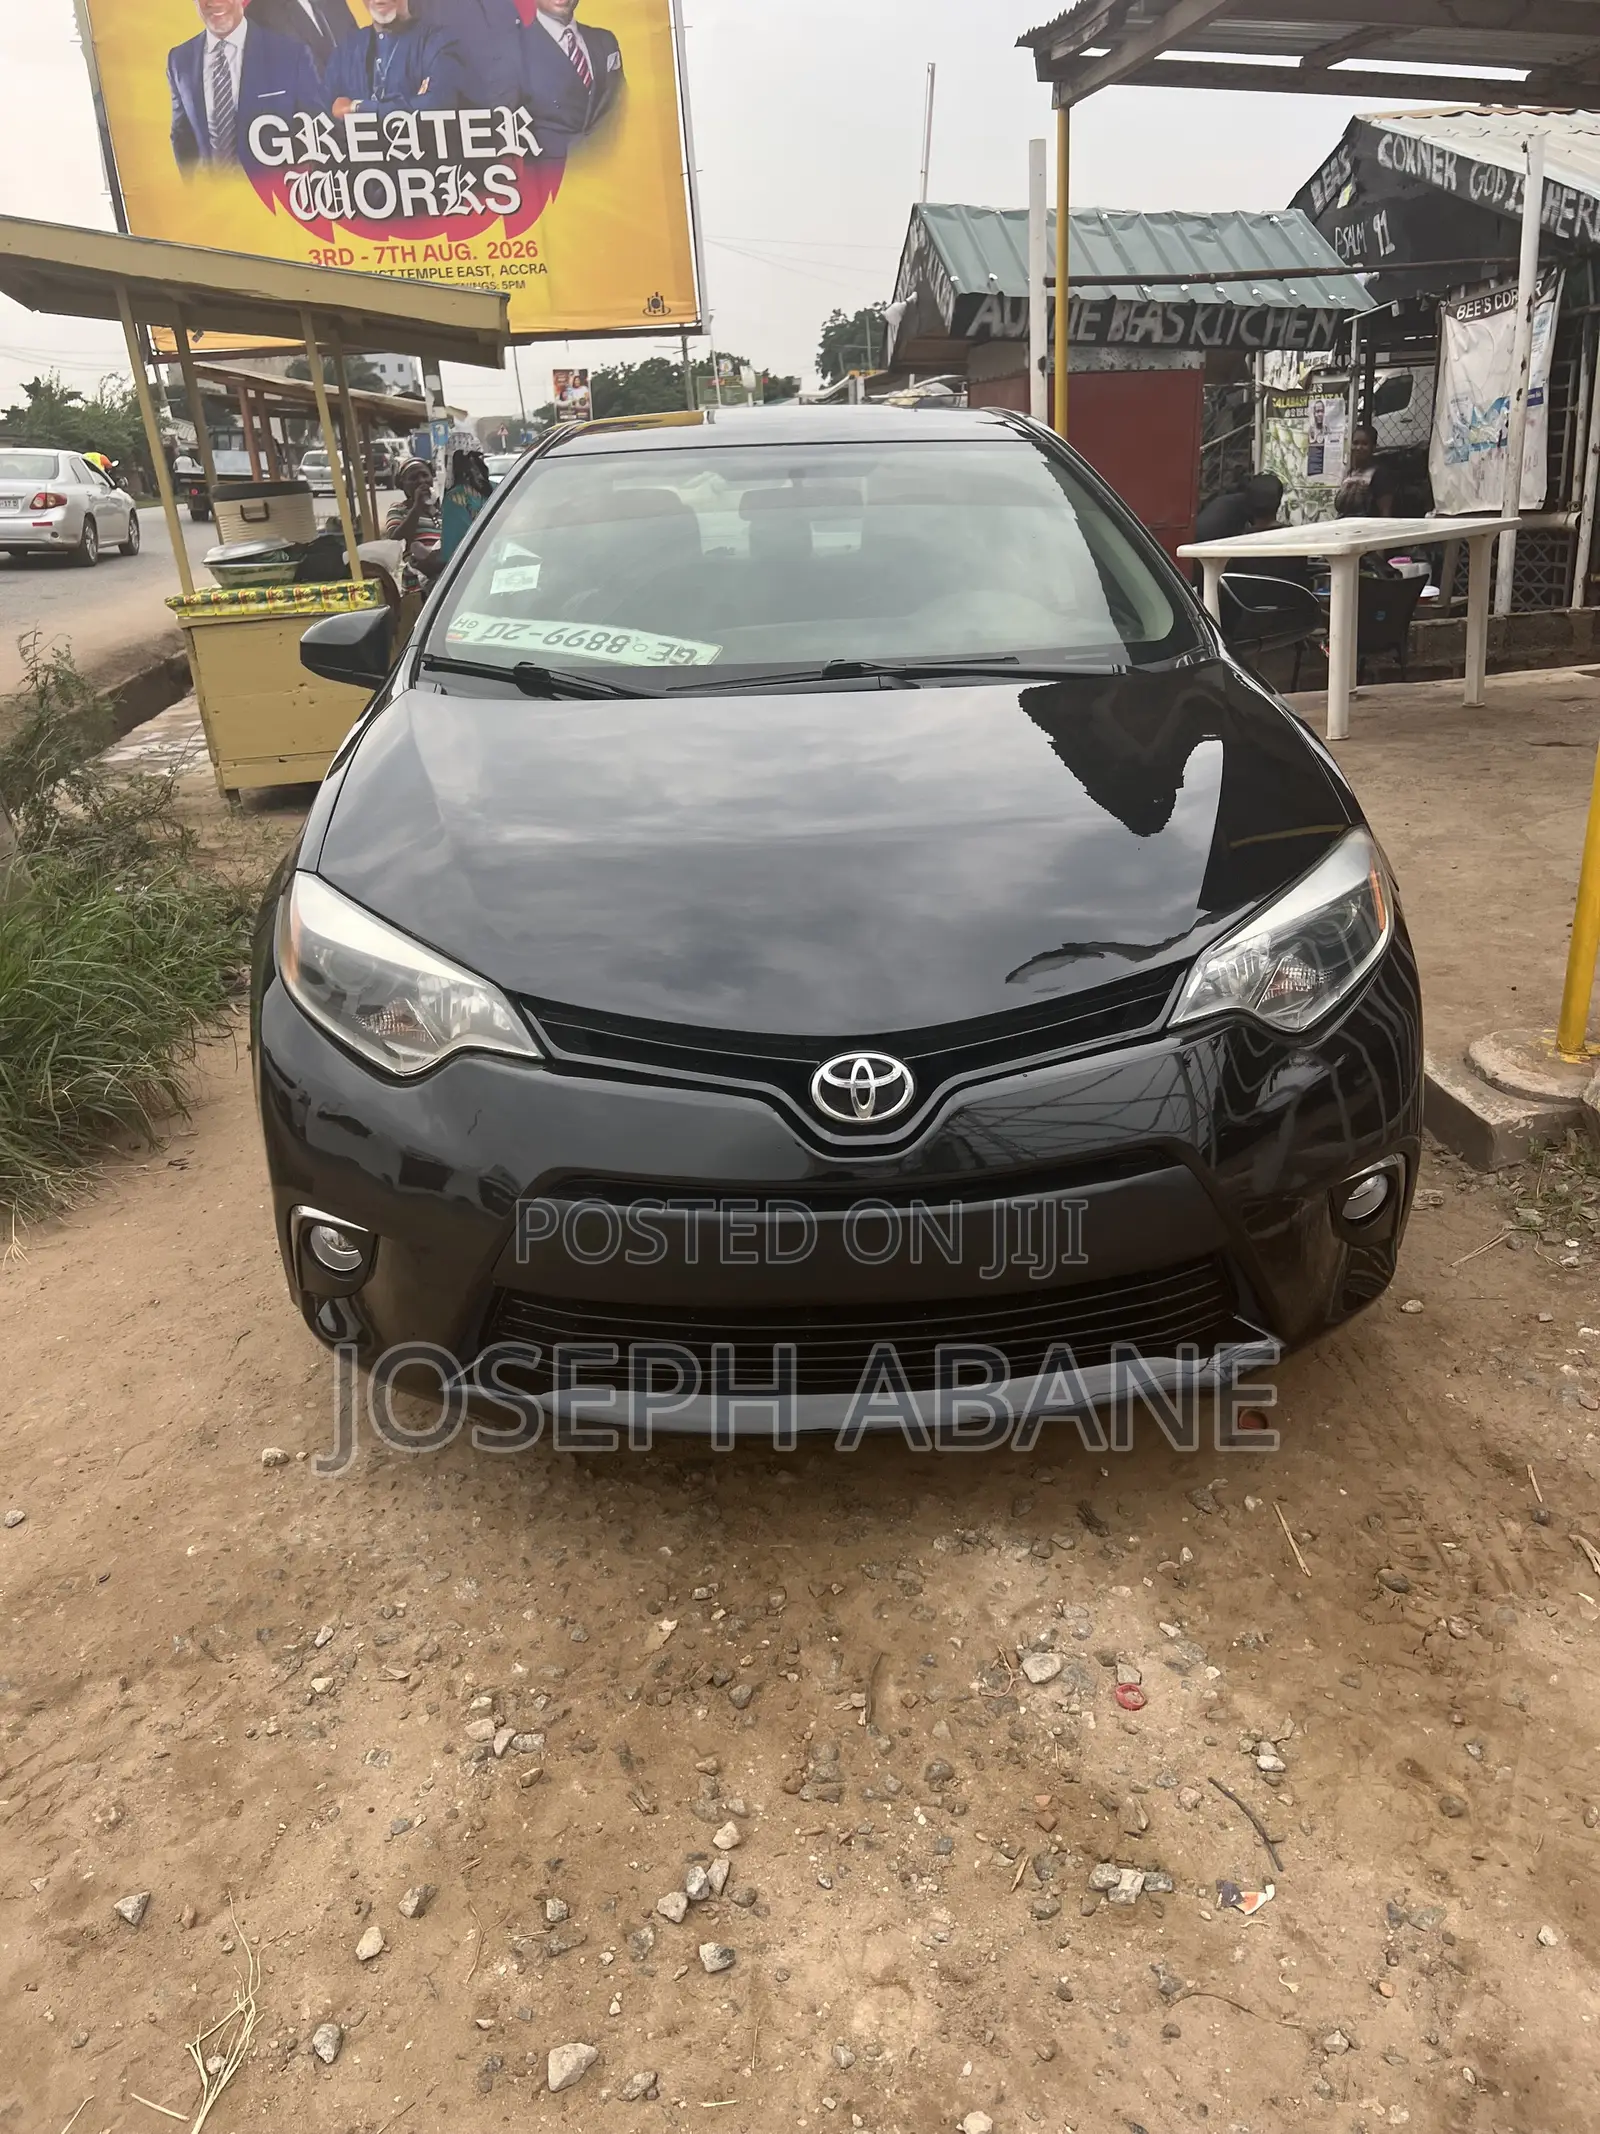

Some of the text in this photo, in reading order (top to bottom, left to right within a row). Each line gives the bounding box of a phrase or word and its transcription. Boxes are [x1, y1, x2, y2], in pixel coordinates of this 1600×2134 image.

[248, 105, 543, 167] GREATER
[1377, 133, 1458, 192] CORNER
[1469, 161, 1507, 204] GOD
[283, 164, 521, 221] WORKS
[308, 248, 355, 266] 3RD
[373, 246, 417, 264] 7TH
[423, 243, 478, 262] AUG.
[487, 241, 538, 260] 2026
[1335, 209, 1395, 259] PSALM 91
[398, 267, 453, 280] TEMPLE
[457, 265, 495, 279] EAST,
[500, 262, 548, 276] ACCRA
[501, 280, 526, 290] 5PM
[1456, 281, 1542, 321] BEE'S CORR
[1188, 303, 1340, 350] KITCHEN
